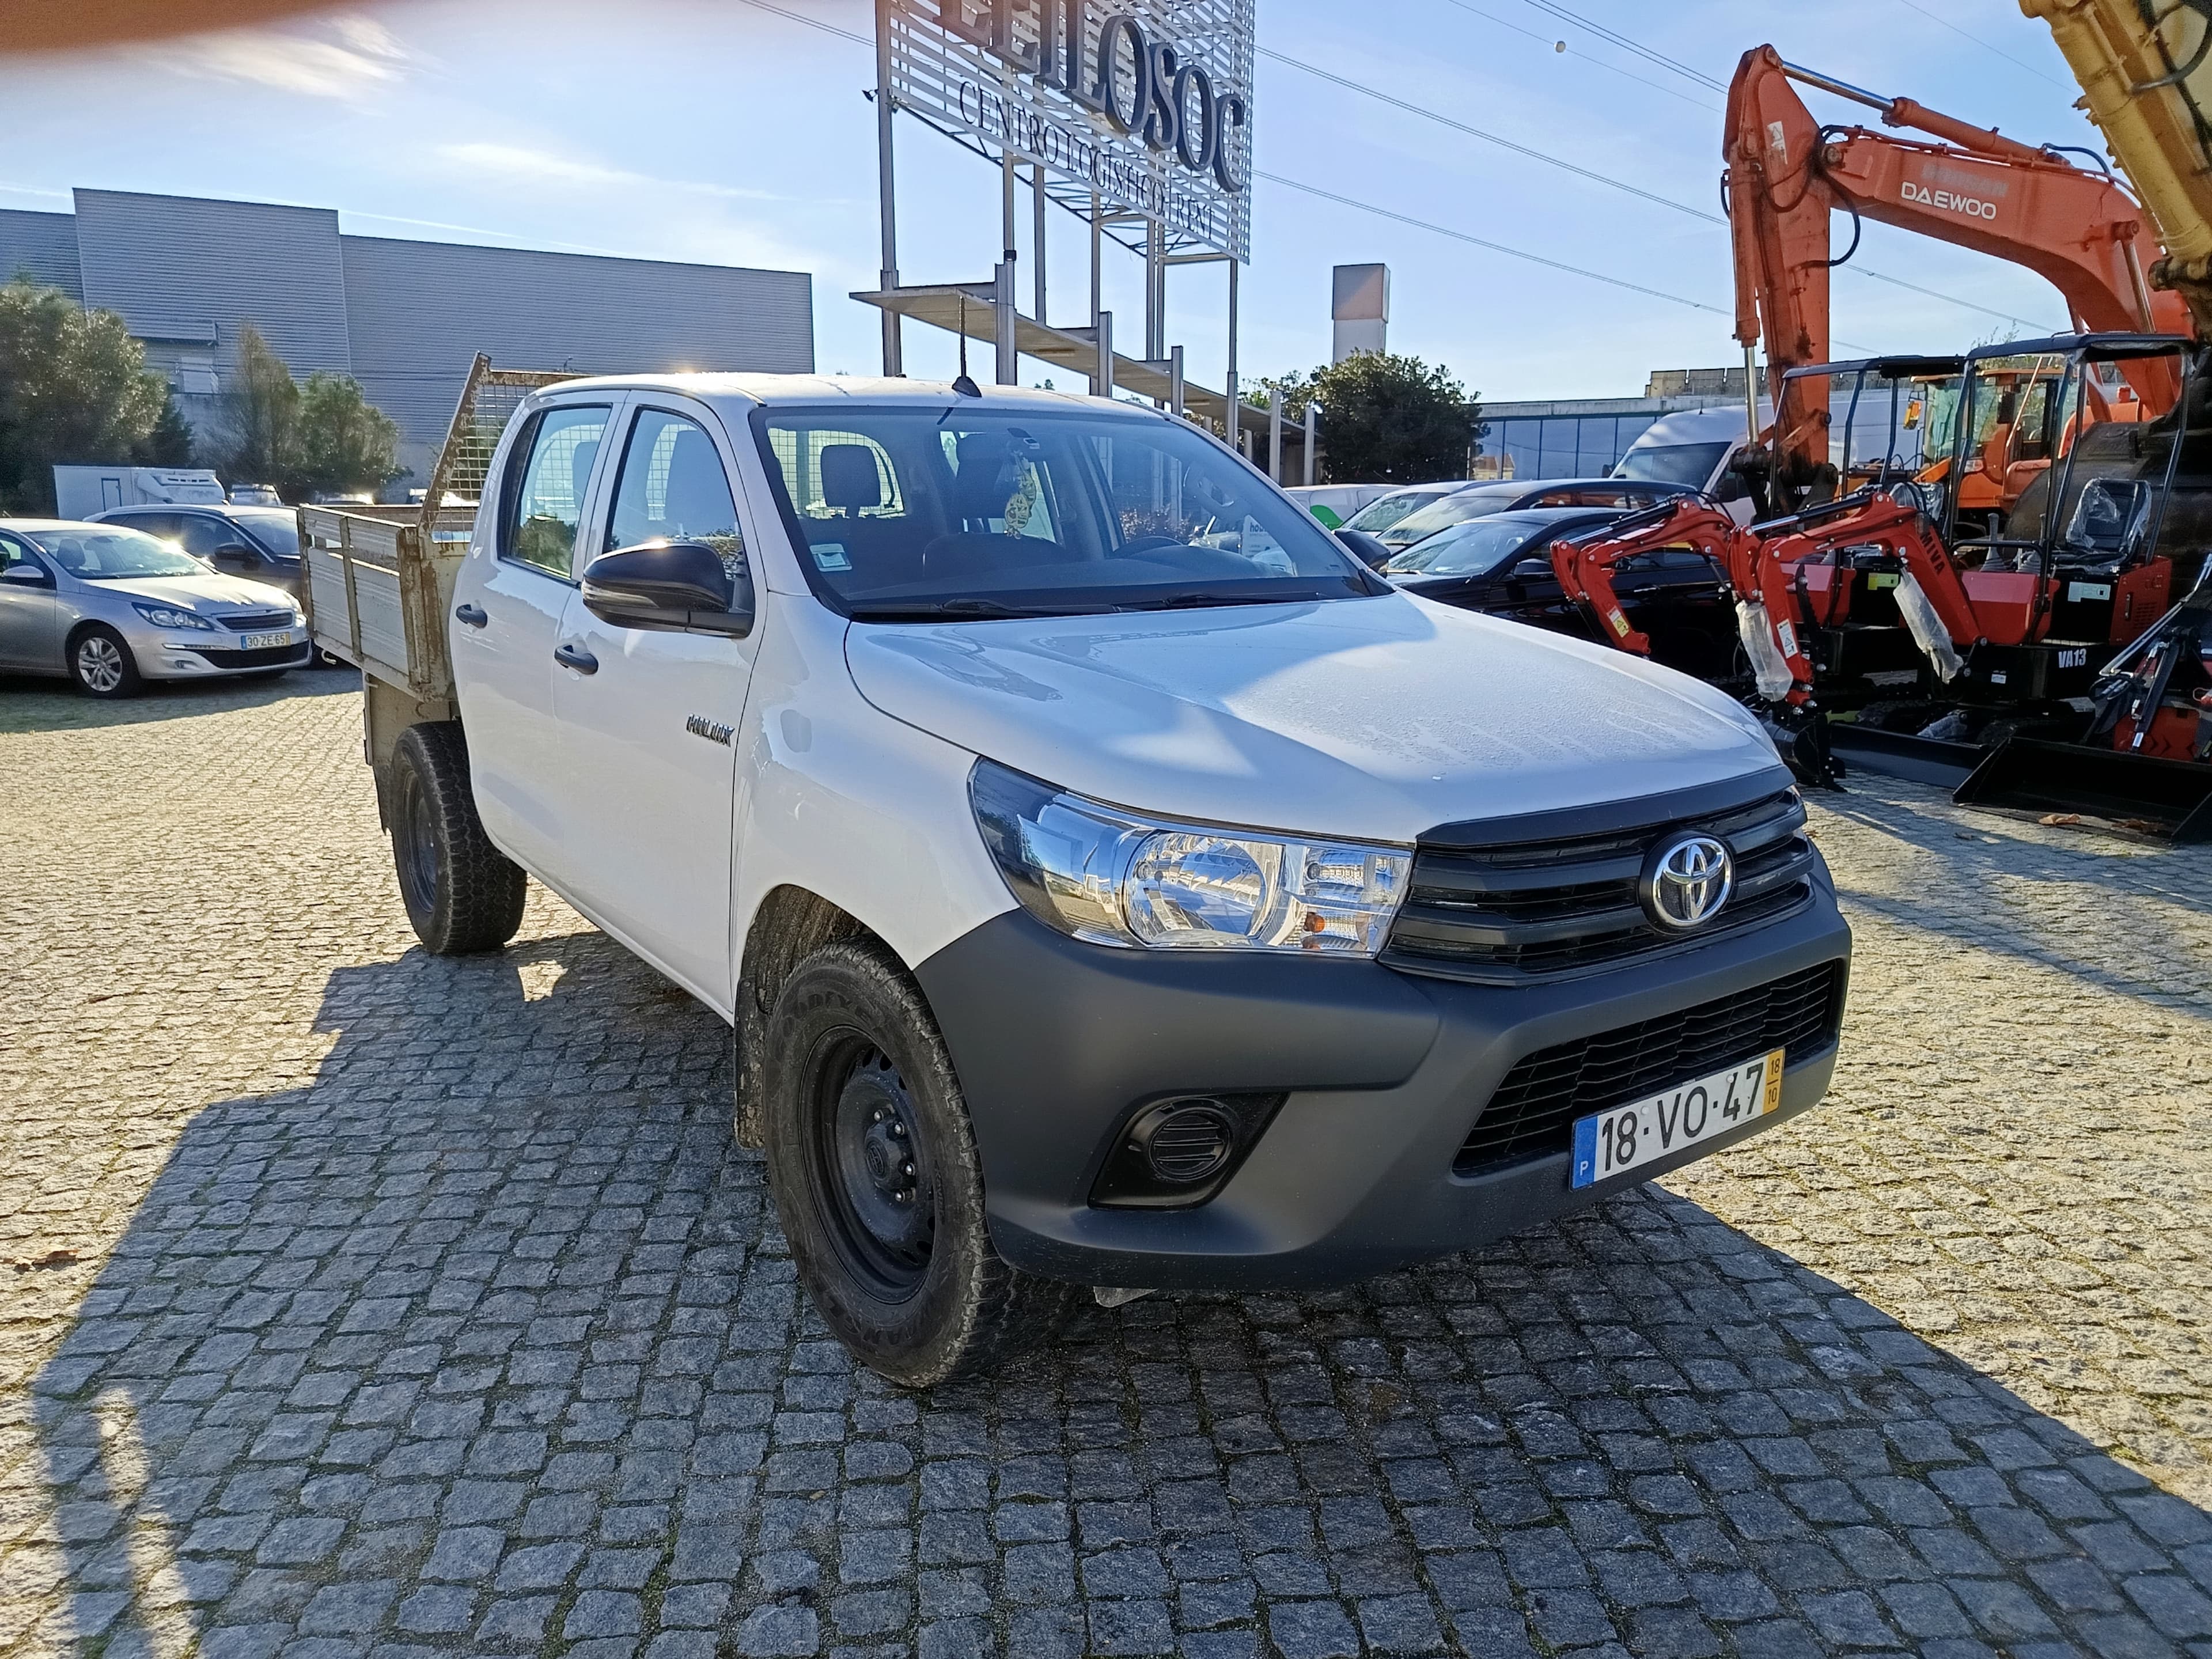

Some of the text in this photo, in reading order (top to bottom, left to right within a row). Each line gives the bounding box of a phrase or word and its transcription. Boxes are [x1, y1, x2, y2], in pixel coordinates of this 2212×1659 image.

[959, 81, 1058, 164] CENTRO
[1901, 181, 1997, 220] DAEWOO
[1920, 532, 1945, 575] MIVA
[2058, 648, 2087, 668] VA13
[686, 713, 735, 748] HILUX
[1771, 1058, 1781, 1076] 18
[1768, 1087, 1778, 1105] 10
[1580, 1160, 1589, 1176] P
